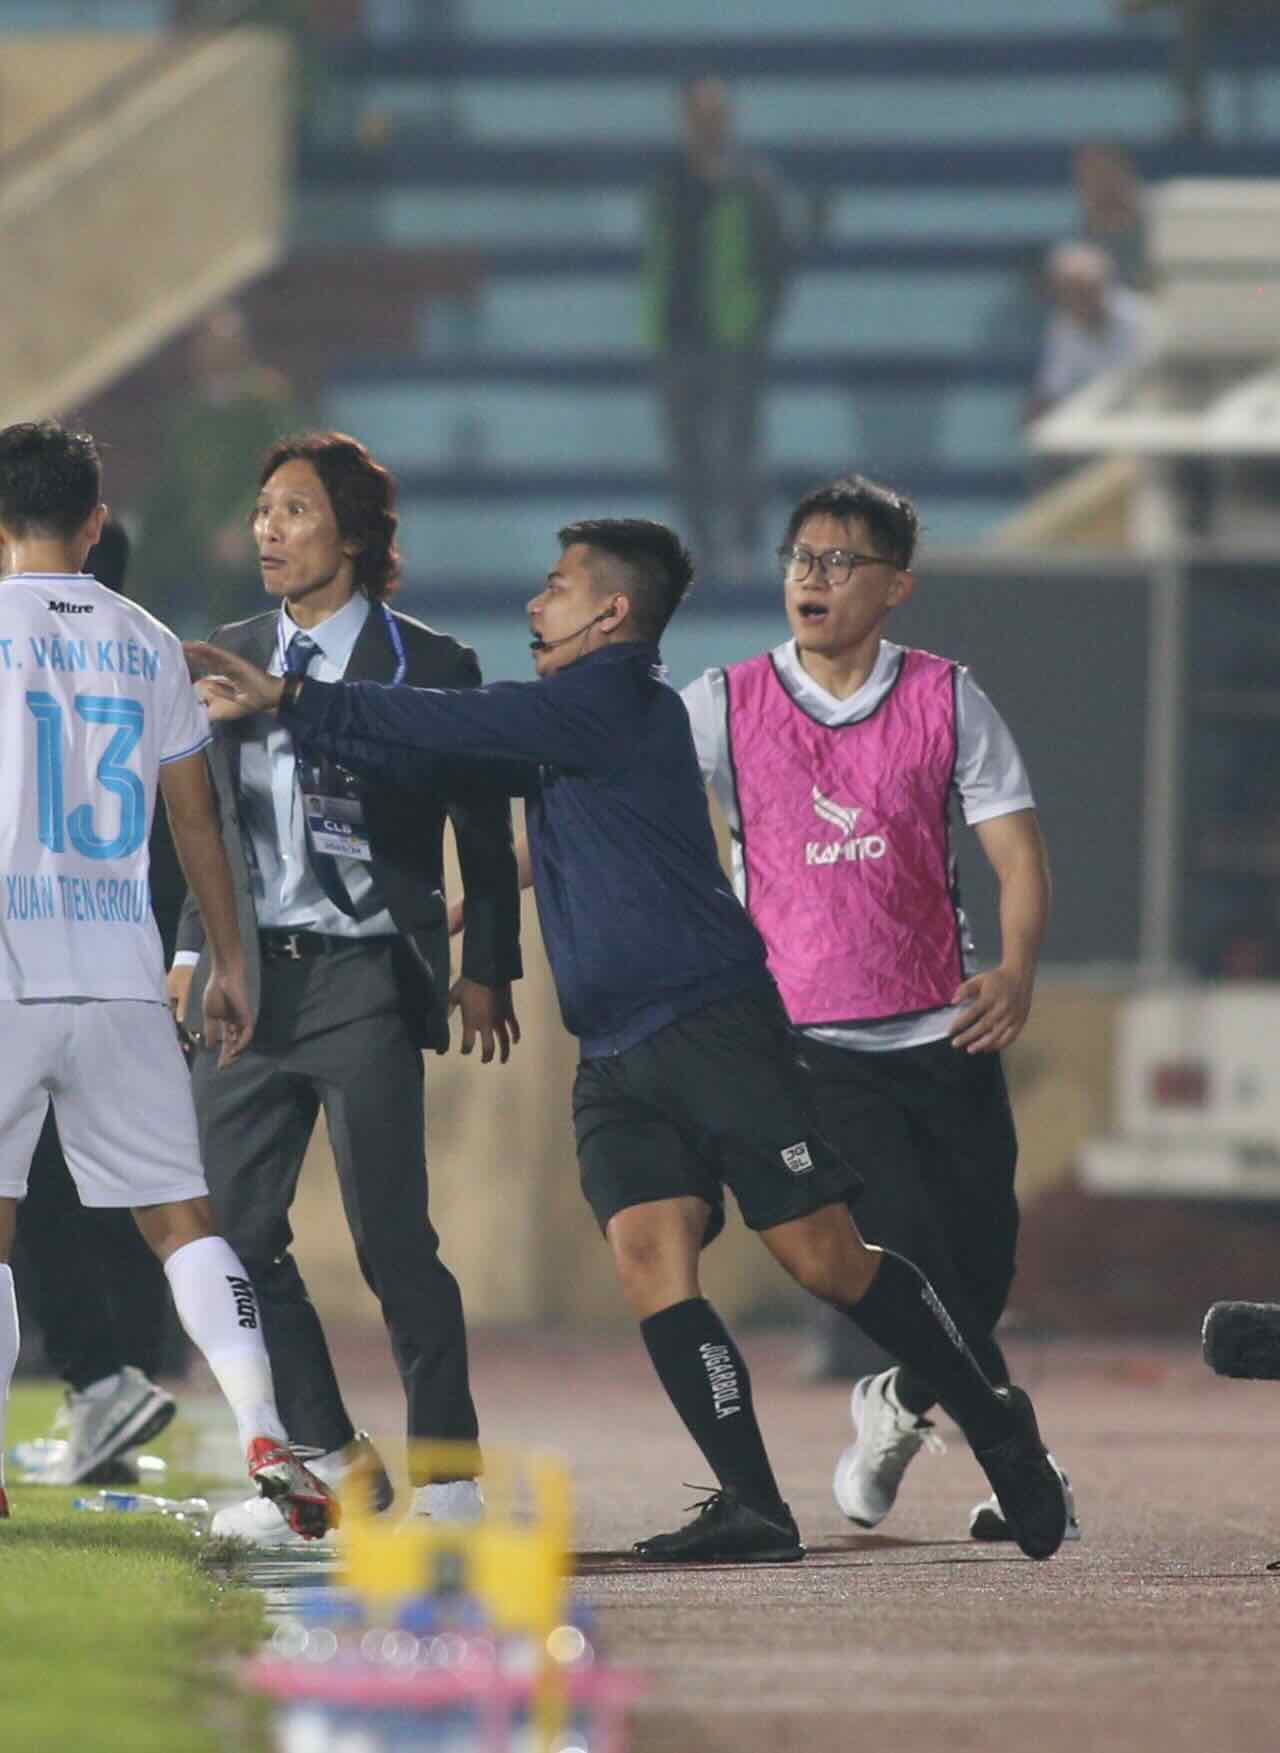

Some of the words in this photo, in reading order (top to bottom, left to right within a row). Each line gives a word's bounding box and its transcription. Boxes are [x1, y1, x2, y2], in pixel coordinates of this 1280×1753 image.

[47, 600, 95, 615] Mitre
[30, 632, 87, 673] VĂN
[25, 690, 146, 861] 13
[228, 1275, 258, 1330] Mitre
